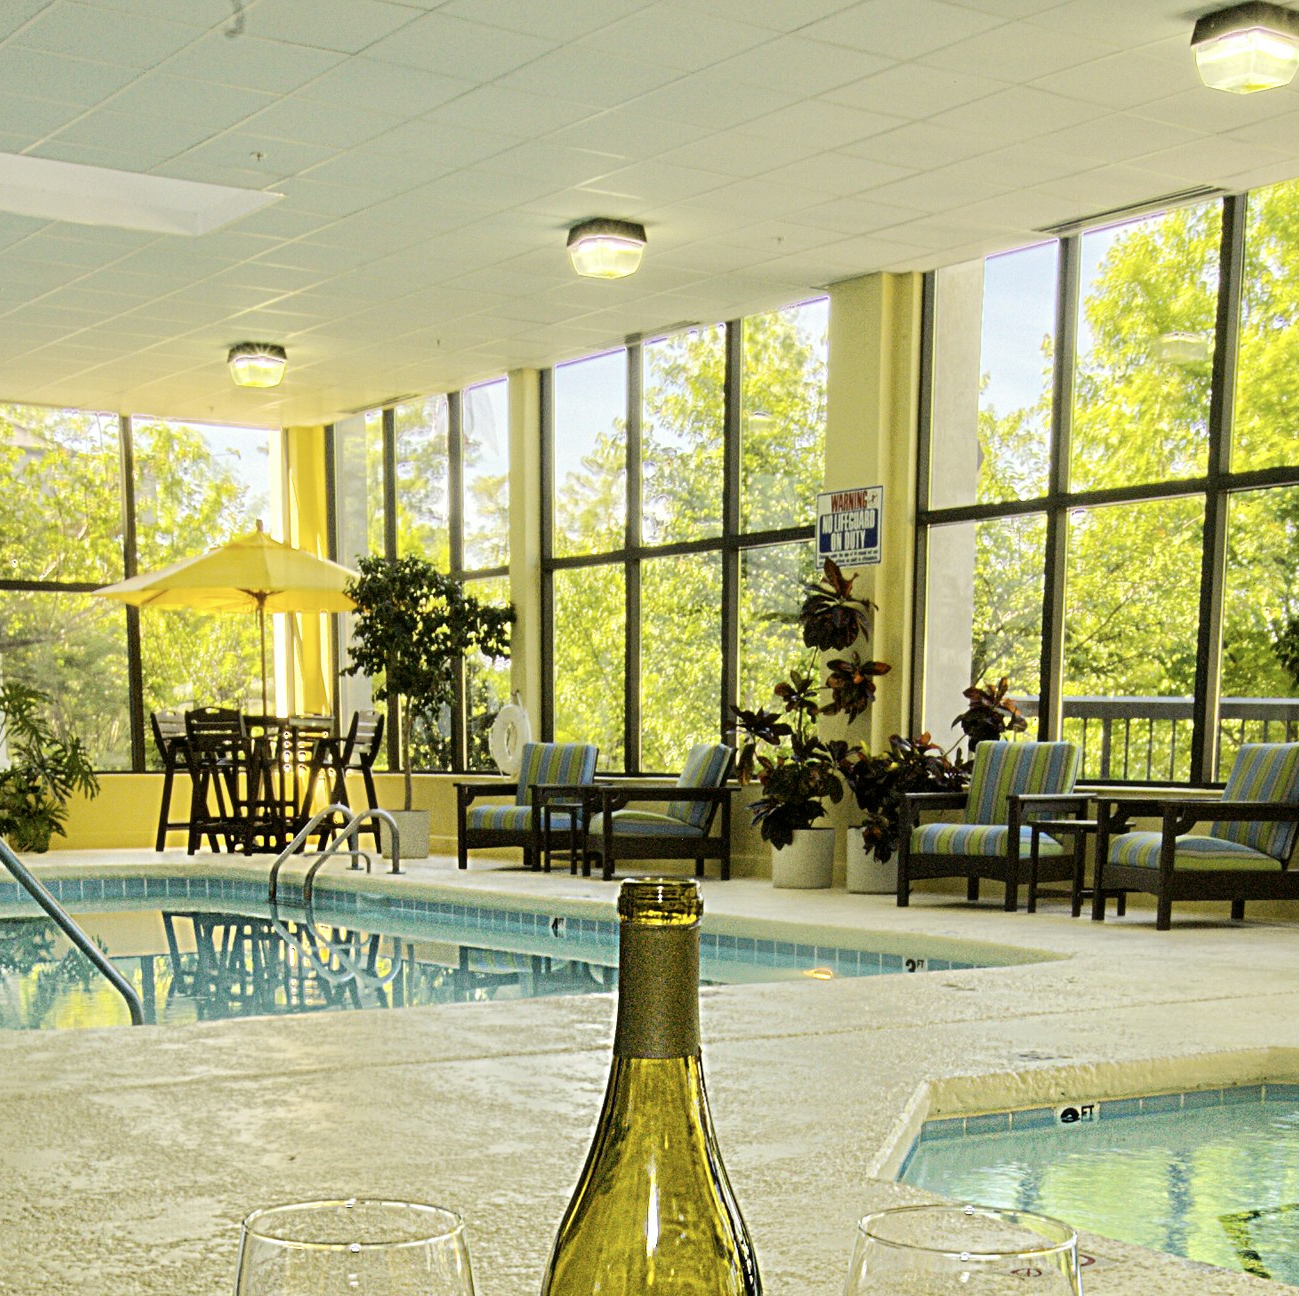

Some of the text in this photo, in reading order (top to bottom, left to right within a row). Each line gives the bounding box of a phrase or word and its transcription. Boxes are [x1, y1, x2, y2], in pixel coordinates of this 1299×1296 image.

[831, 491, 868, 513] WARNING
[822, 509, 876, 535] NO LIFEGUARD
[830, 529, 866, 552] ON DUTY
[1081, 1104, 1095, 1121] FT
